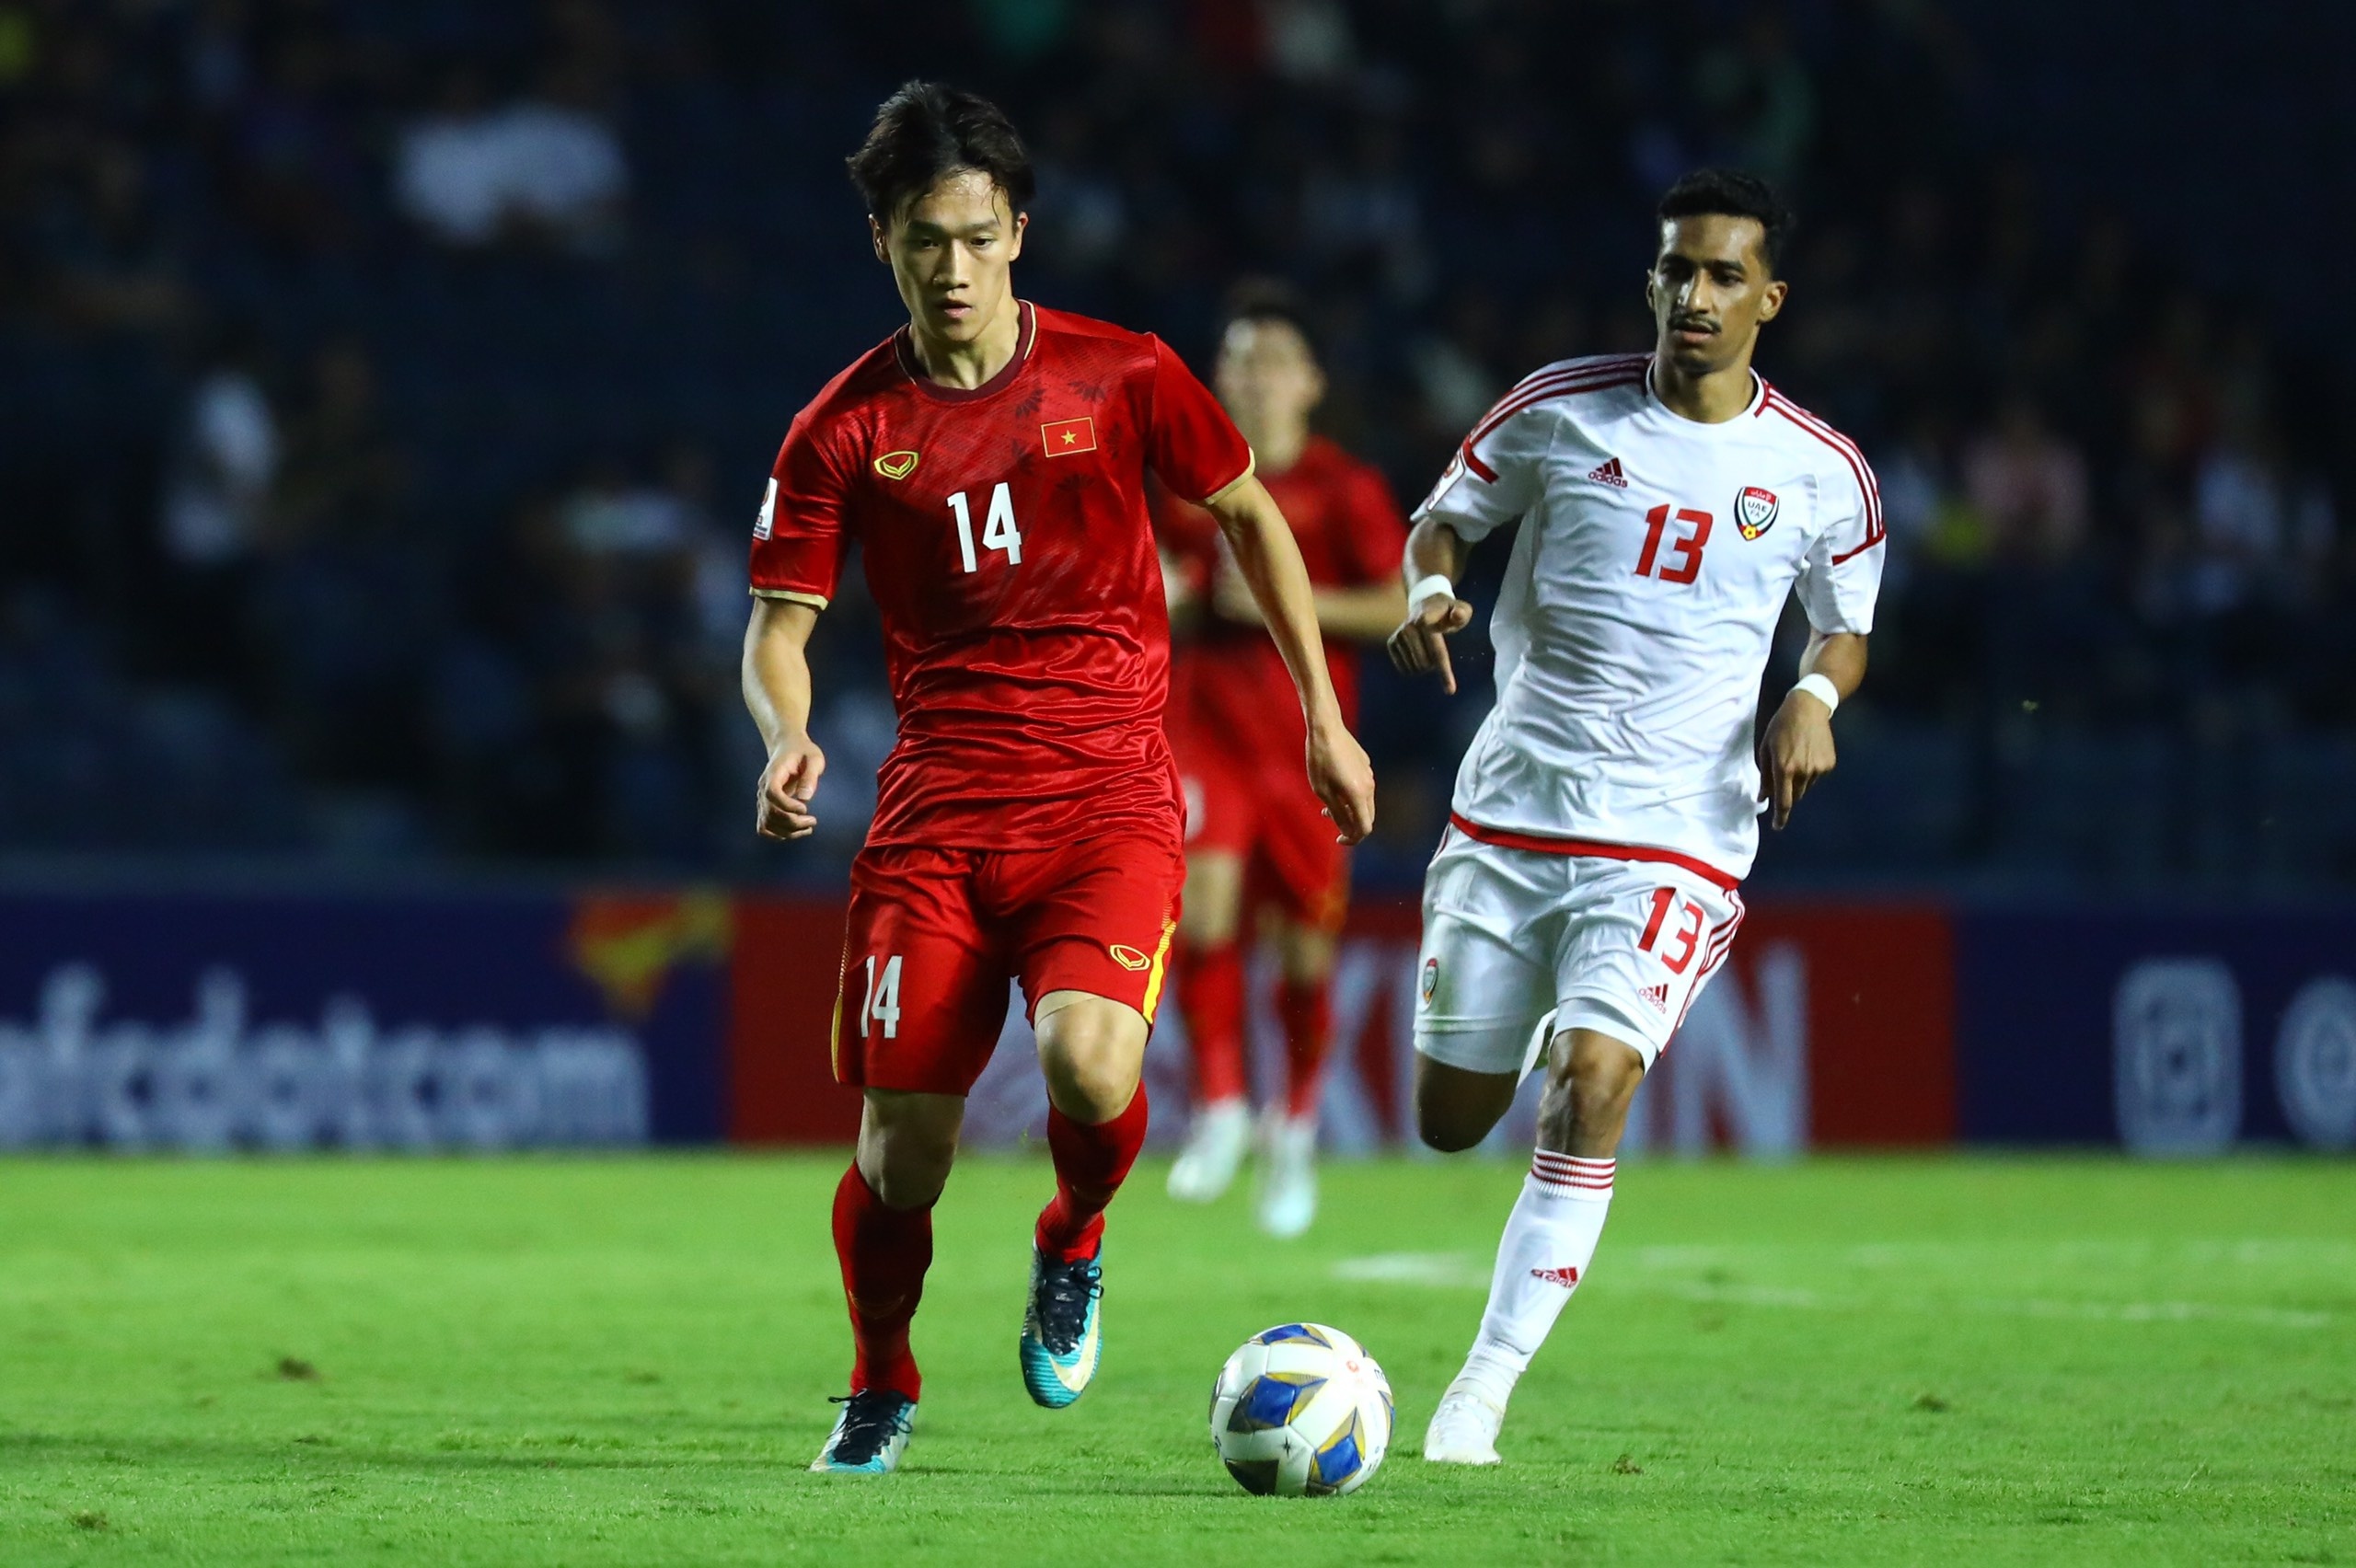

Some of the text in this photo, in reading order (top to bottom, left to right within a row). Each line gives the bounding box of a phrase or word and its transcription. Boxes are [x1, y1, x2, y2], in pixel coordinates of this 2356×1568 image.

[1588, 472, 1627, 488] adidas
[947, 482, 1022, 572] 14
[1748, 502, 1767, 513] UAE
[1750, 510, 1760, 518] FA
[1634, 503, 1714, 584] 13
[1638, 887, 1703, 975] 13
[860, 955, 903, 1038] 14
[1639, 988, 1667, 1014] adidas
